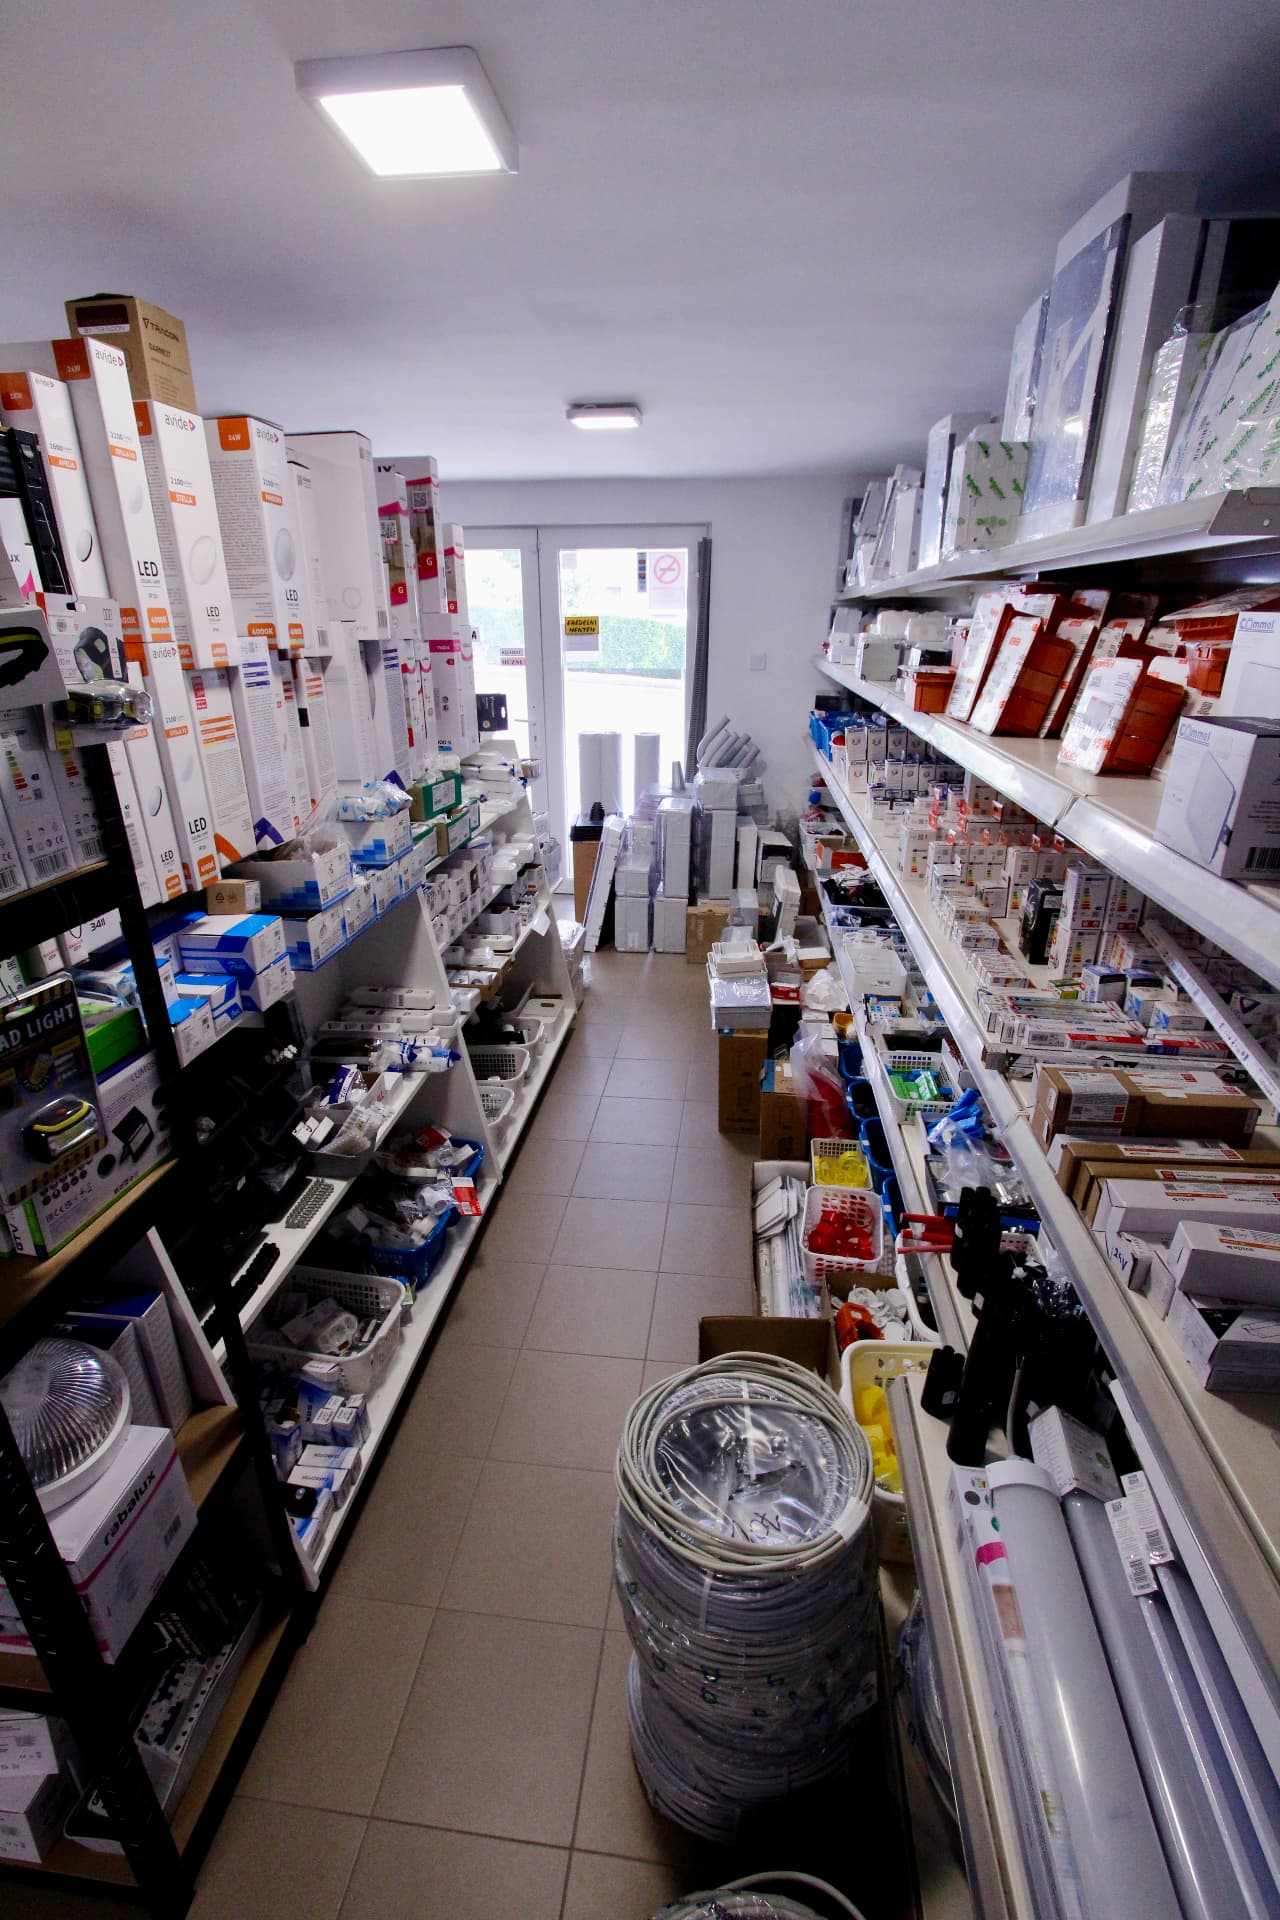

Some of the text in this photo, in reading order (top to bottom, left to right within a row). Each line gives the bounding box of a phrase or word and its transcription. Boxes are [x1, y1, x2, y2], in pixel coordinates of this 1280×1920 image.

[164, 413, 190, 431] avide
[137, 560, 159, 577] LED
[285, 589, 299, 602] LED
[206, 606, 220, 617] LED
[152, 648, 173, 660] avide
[188, 817, 207, 835] LED
[160, 849, 174, 863] LED
[26, 1003, 75, 1039] LIGHT
[103, 1470, 156, 1547] rabalux
